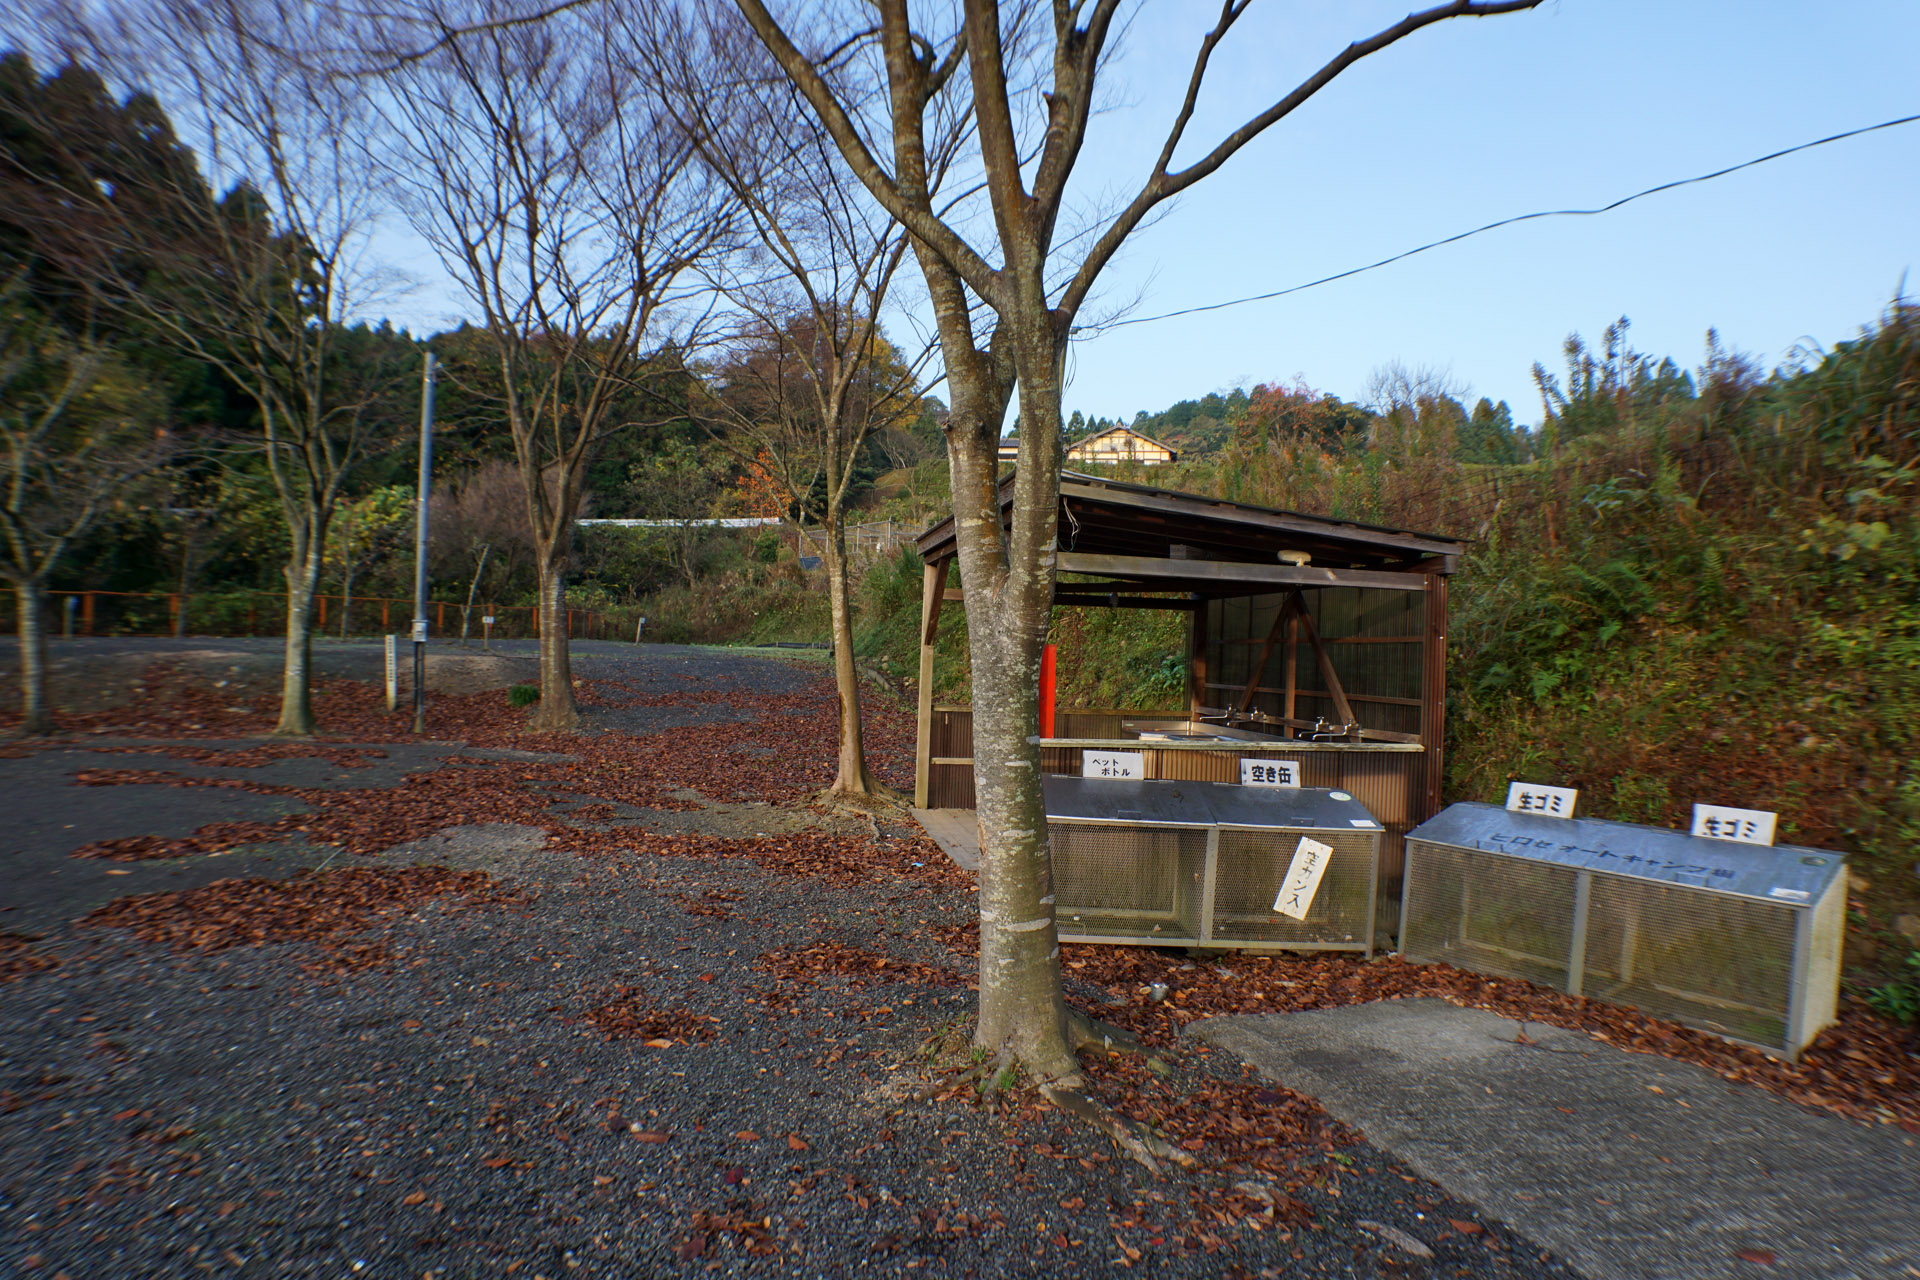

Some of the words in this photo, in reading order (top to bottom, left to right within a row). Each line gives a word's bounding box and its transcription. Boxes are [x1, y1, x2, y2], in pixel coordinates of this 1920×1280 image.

[1101, 767, 1130, 777] ボトル
[1251, 764, 1291, 784] 空き缶
[1518, 791, 1562, 813] 生ゴミ
[1701, 815, 1758, 839] 生ゴミ
